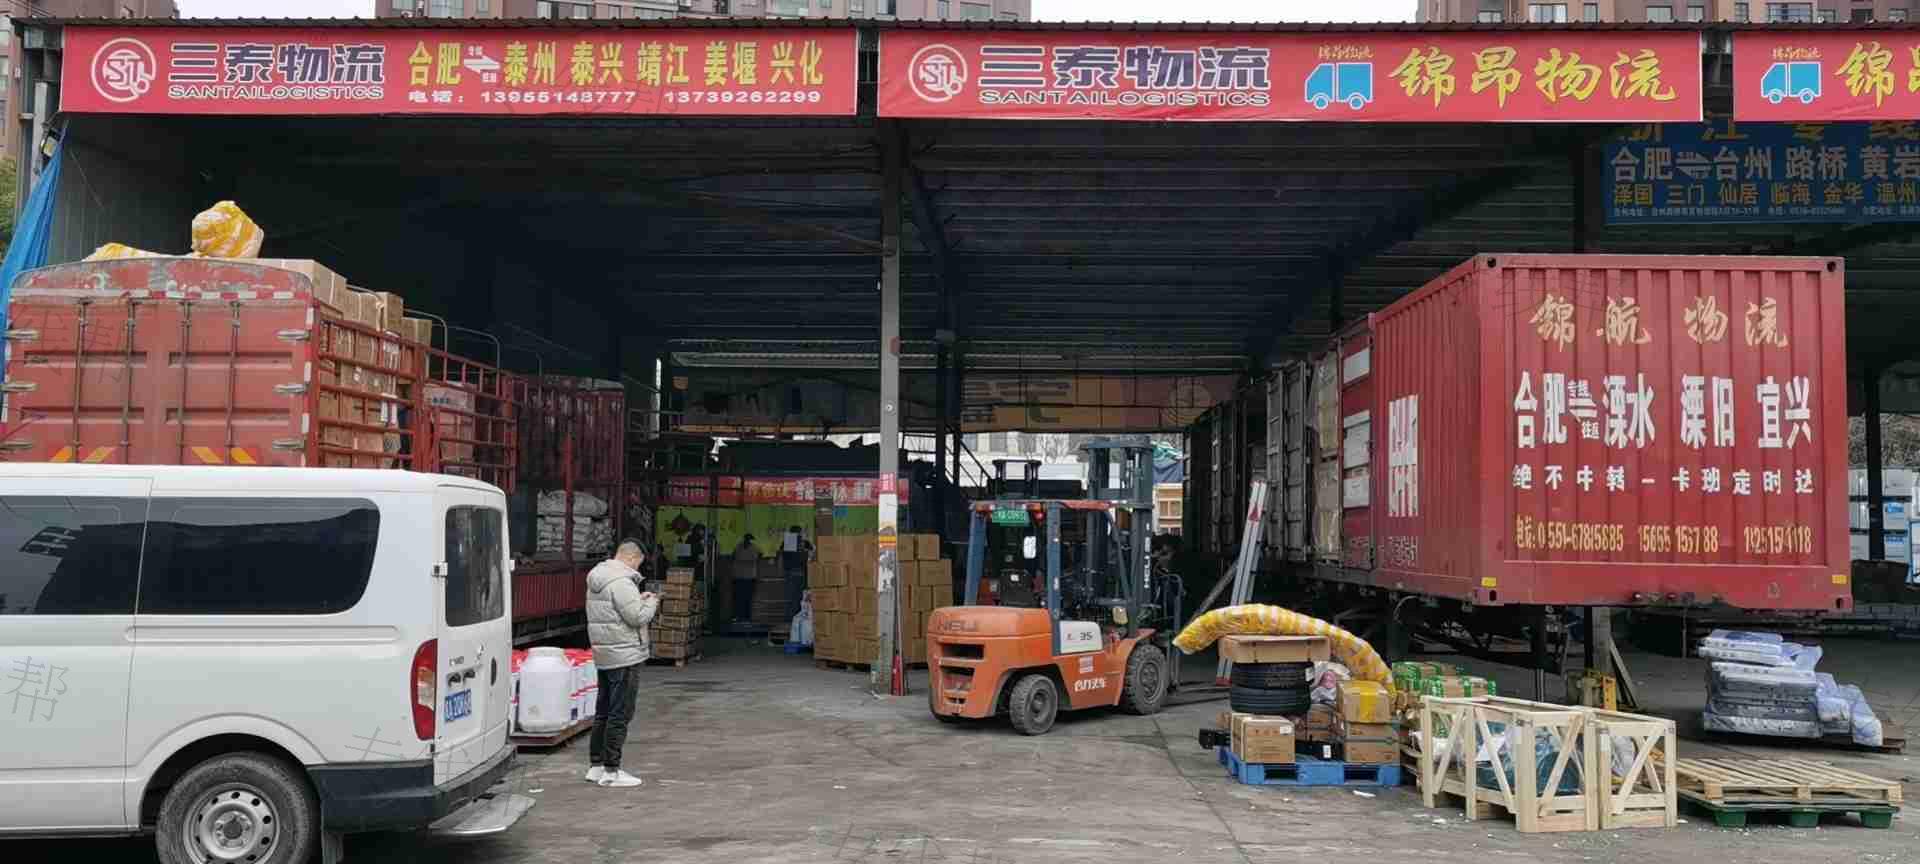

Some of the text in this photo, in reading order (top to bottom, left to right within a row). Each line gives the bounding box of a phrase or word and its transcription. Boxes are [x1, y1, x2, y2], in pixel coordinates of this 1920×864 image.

[168, 42, 385, 83] 三泰物流
[408, 40, 823, 86] 合肥 泰州 泰兴 靖江 姜堰 兴化
[978, 45, 1271, 90] 三泰物流
[1388, 45, 1676, 109] 锦昂物流
[1835, 41, 1920, 109] 锦
[664, 91, 821, 103] 13739262299
[1611, 146, 1673, 181] 合肥
[1712, 146, 1773, 181] 台州
[1784, 146, 1848, 181] 路桥
[1667, 183, 1704, 205] 三门
[1719, 183, 1759, 205] 仙居
[1823, 183, 1865, 205] 金华
[1514, 371, 1811, 449] 合肥 溧水 溧阳 宜兴
